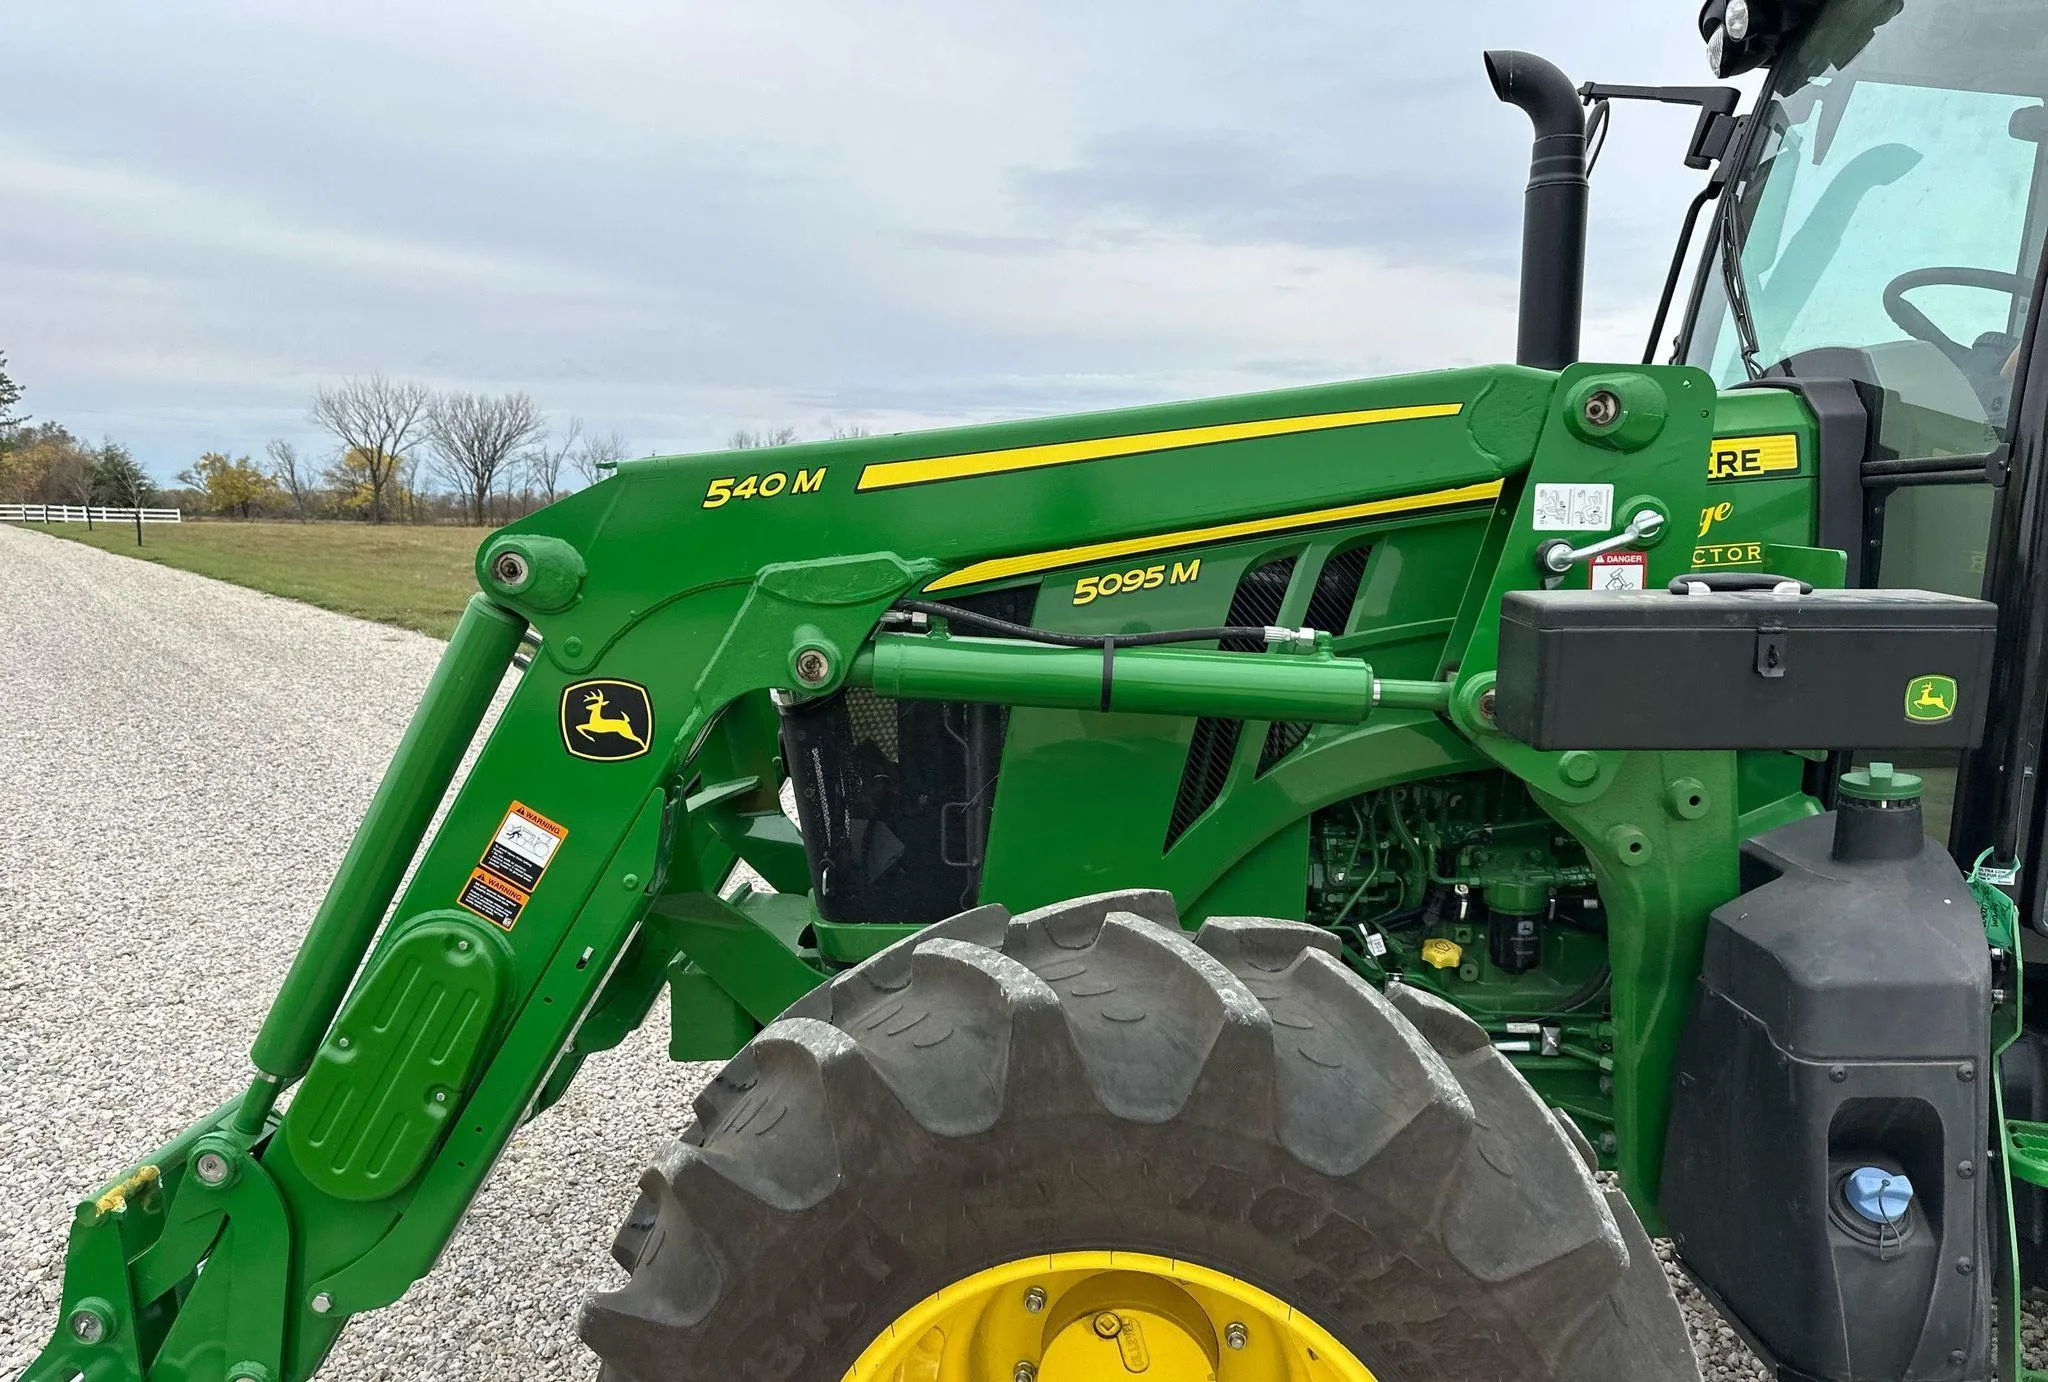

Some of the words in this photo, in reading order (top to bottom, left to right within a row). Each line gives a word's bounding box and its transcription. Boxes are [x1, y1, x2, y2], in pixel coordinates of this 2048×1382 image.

[1708, 449, 1761, 474] RE
[702, 472, 787, 509] 540
[790, 466, 828, 495] M
[1606, 554, 1643, 564] DANGER
[1072, 564, 1167, 606] 5095
[1170, 558, 1202, 585] M
[526, 811, 560, 835] WARNING
[488, 878, 522, 901] WARNING
